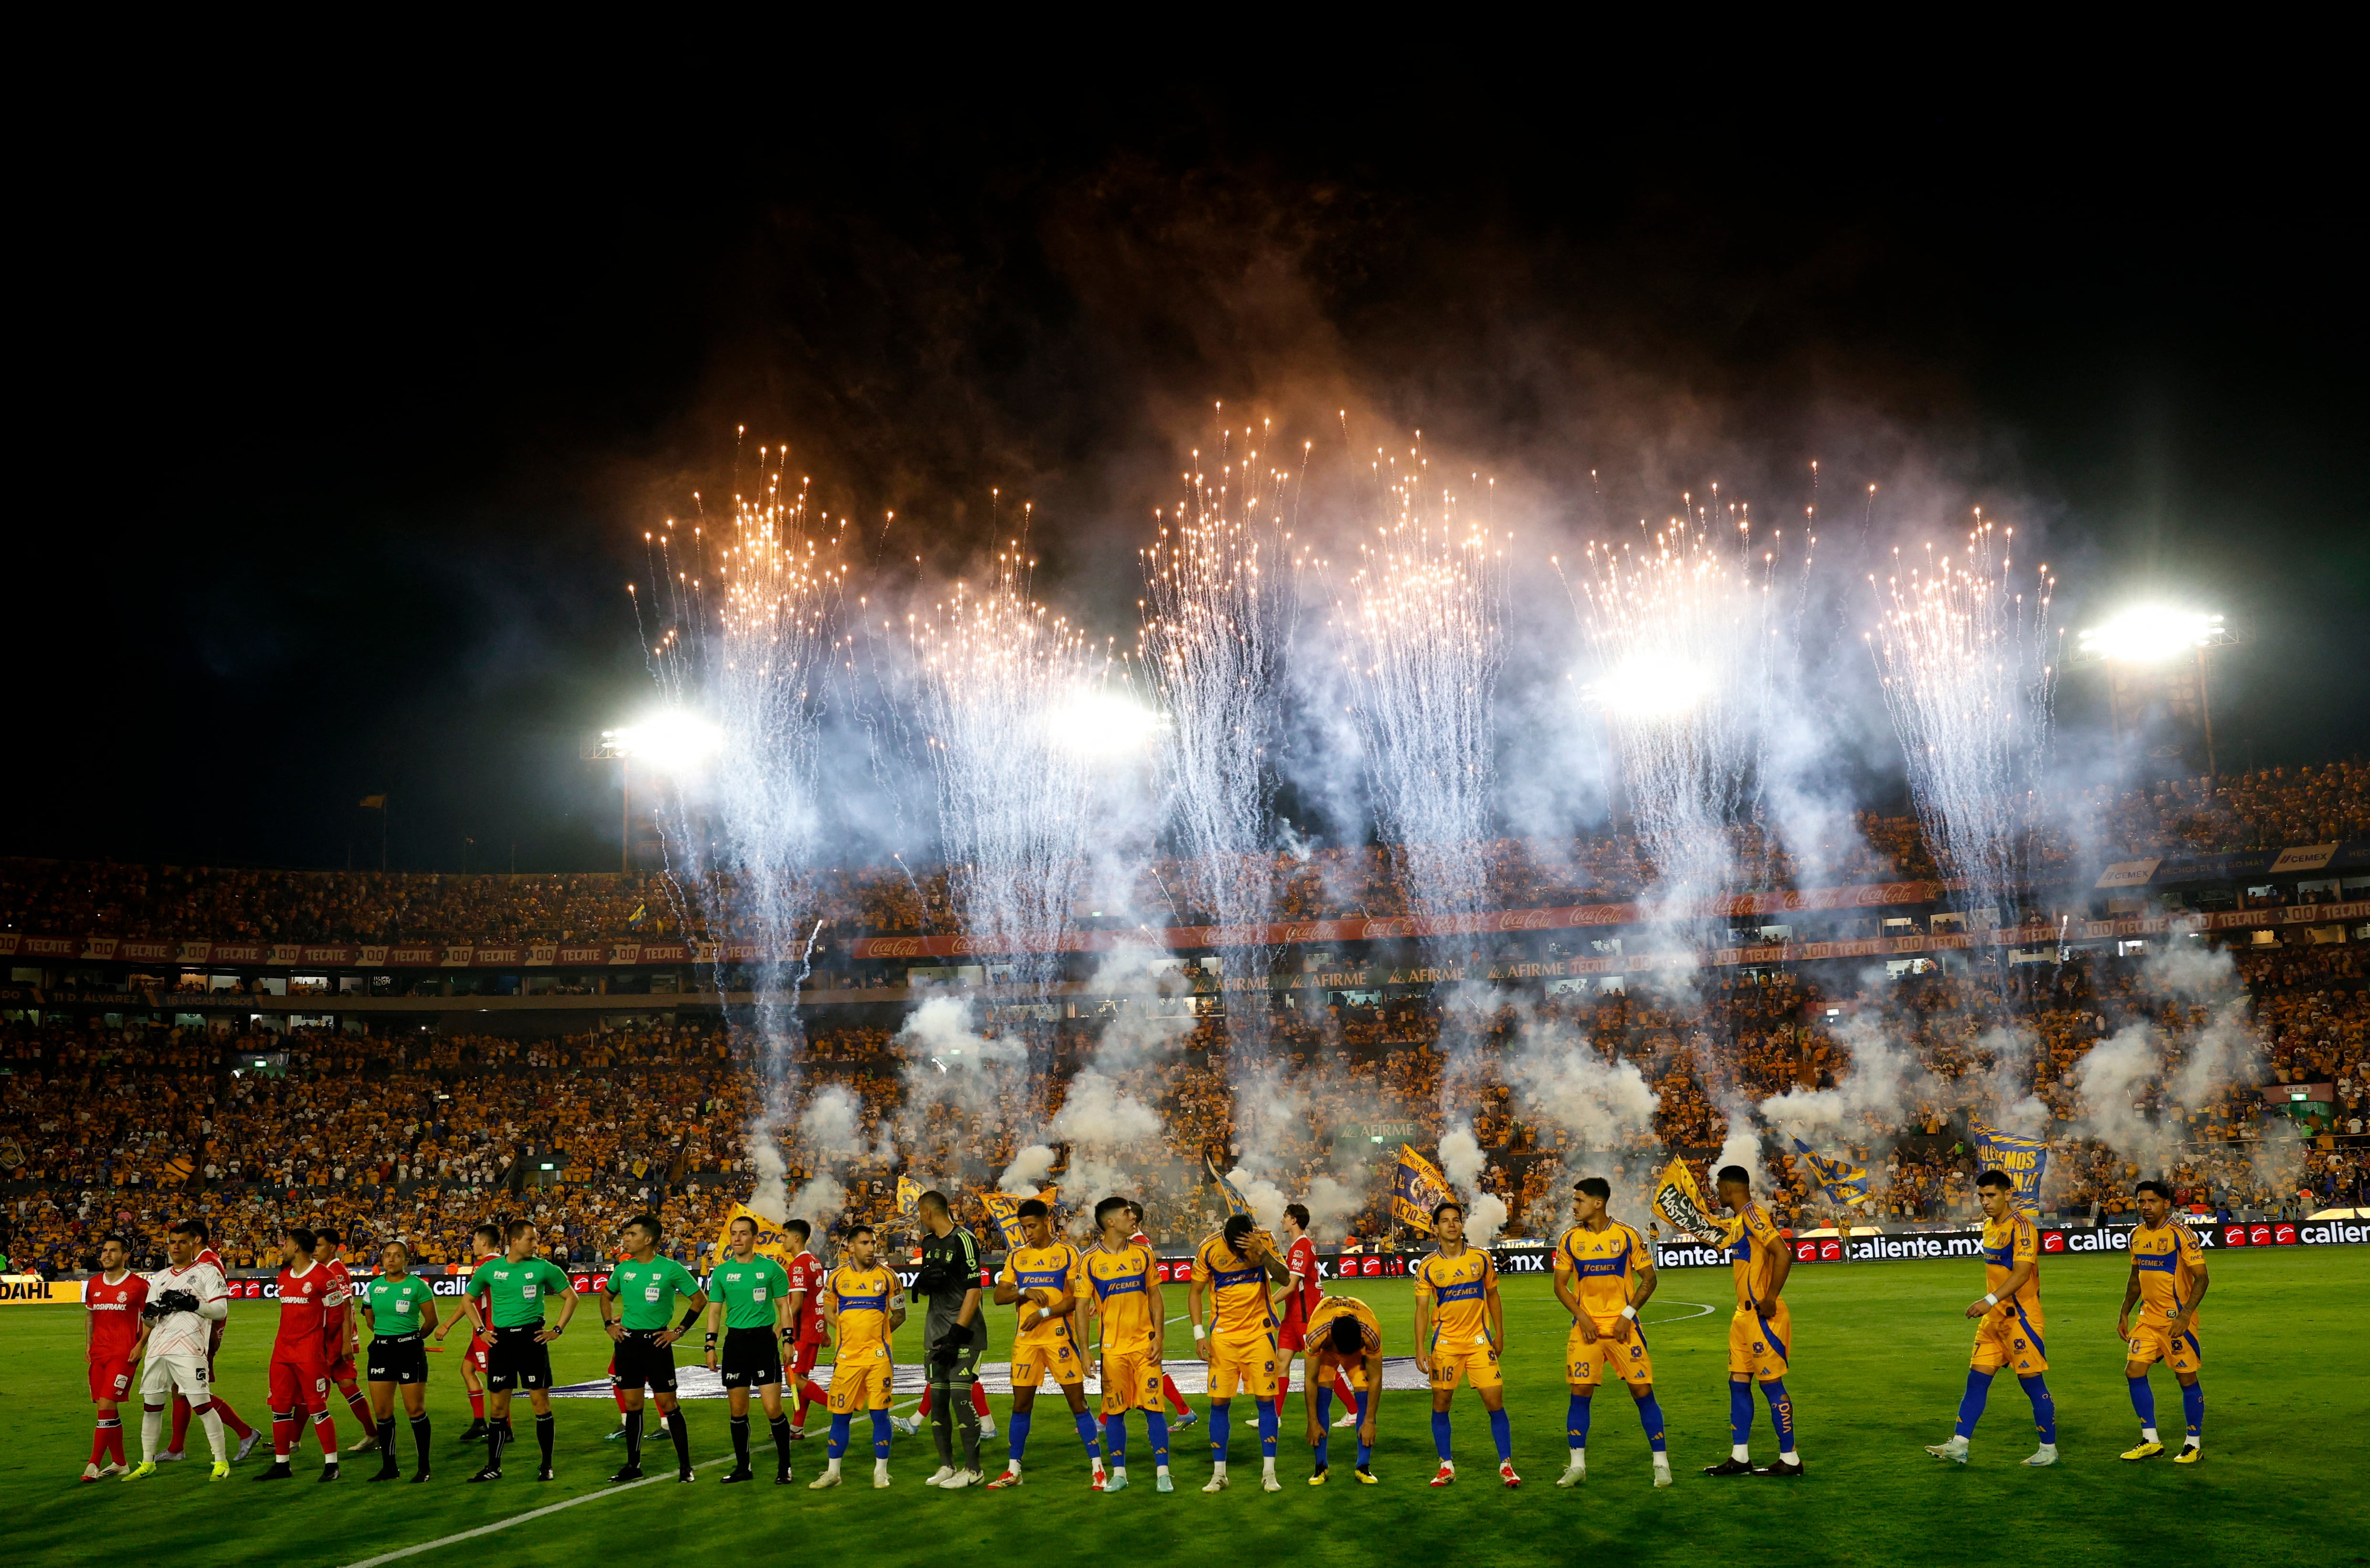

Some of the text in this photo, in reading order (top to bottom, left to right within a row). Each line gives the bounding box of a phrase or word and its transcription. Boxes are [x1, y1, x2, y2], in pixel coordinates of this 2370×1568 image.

[2291, 853, 2328, 863] CEMEX
[2160, 865, 2196, 875] HECHOS
[2217, 860, 2243, 870] ALGO
[2115, 870, 2149, 880] CEMEX
[2218, 910, 2268, 927] TECATE
[25, 939, 73, 952] TECATE
[1836, 941, 1880, 955] TECATE
[1928, 934, 1973, 950] TECATE
[122, 944, 168, 957] TECATE
[215, 947, 258, 960] TECATE
[305, 949, 347, 961] TECATE
[392, 950, 433, 962] TECATE
[477, 950, 517, 962] TECATE
[561, 949, 601, 961] TECATE
[644, 947, 684, 960] TECATE
[1746, 947, 1789, 962] TECATE
[1408, 967, 1465, 983] AFIRME
[1508, 962, 1564, 978] AFIRME
[1214, 977, 1269, 991] AFIRME
[1311, 972, 1366, 987] AFIRME
[53, 993, 63, 1001] 11
[166, 996, 254, 1006] 16 LUCAS LOBOS
[1361, 1123, 1414, 1137] AFIRME
[1291, 1259, 1303, 1267] Red
[0, 1282, 53, 1300] DAHL
[1116, 1281, 1140, 1289] CEMEX
[1452, 1287, 1478, 1296] CEMEX
[1016, 1364, 1031, 1380] 77
[1442, 1366, 1454, 1382] 16
[1574, 1361, 1590, 1378] 23
[1211, 1375, 1217, 1391] 4
[837, 1393, 845, 1408] 8
[1778, 1401, 1790, 1434] viva
